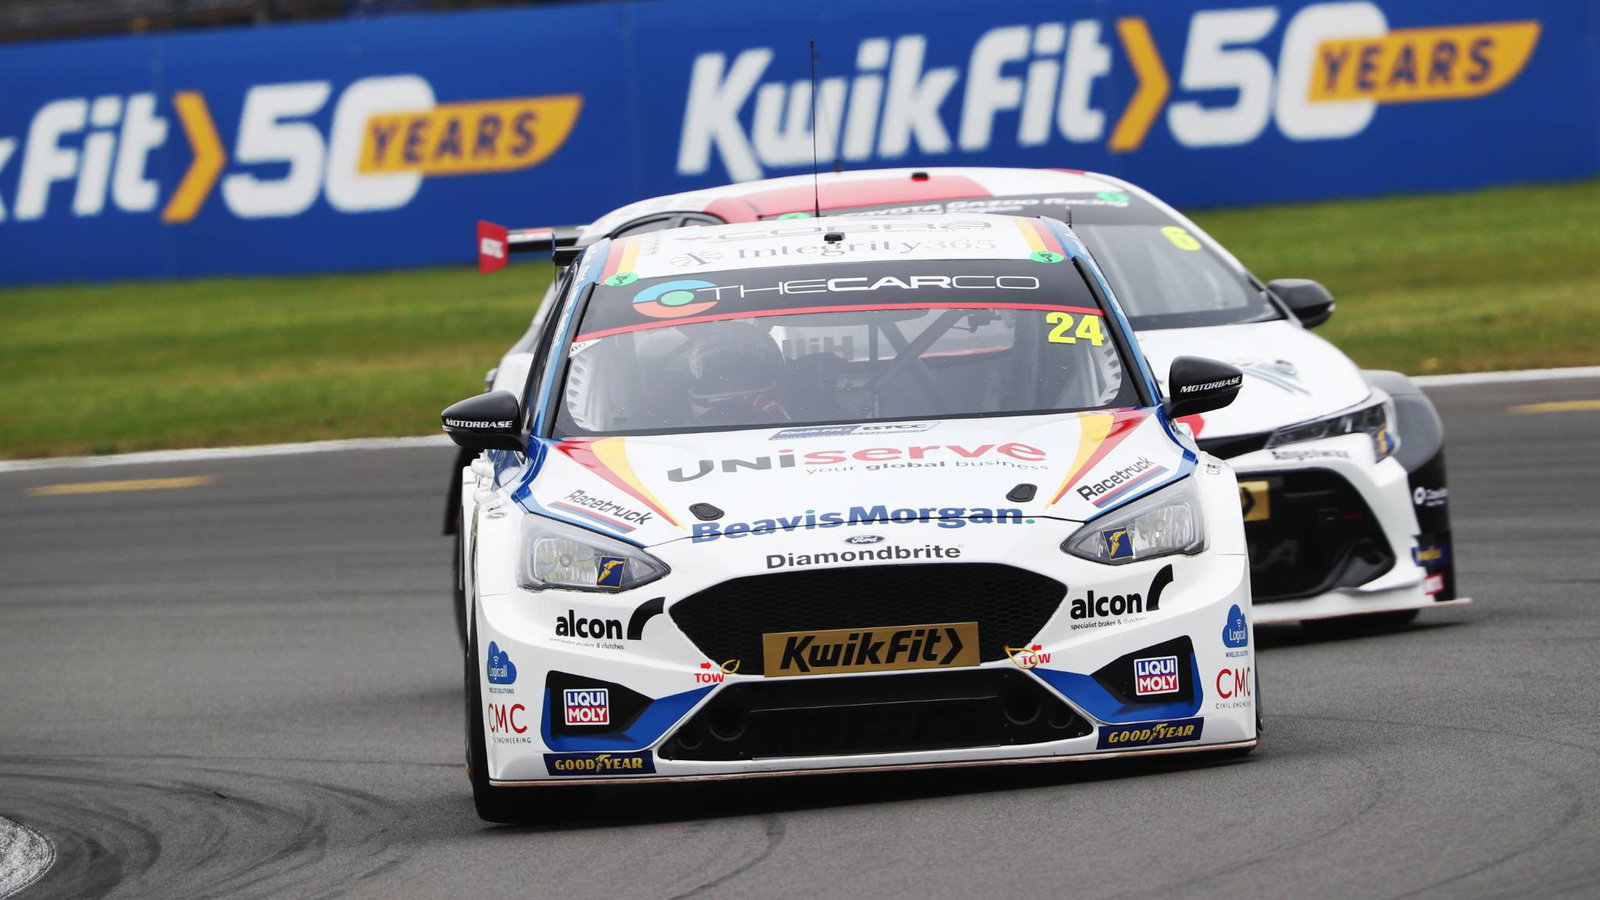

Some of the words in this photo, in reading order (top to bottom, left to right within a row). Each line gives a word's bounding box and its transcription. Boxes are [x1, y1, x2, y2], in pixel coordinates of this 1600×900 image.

[1167, 0, 1391, 148] 50
[1322, 37, 1495, 92] YEARS
[221, 74, 436, 219] 50
[371, 111, 541, 166] YEARS
[1160, 226, 1202, 250] 6
[1046, 312, 1104, 346] 24
[1180, 375, 1241, 393] MOTORBASE
[445, 418, 513, 429] MOTORBASE
[806, 466, 855, 476] your
[866, 461, 946, 472] global
[956, 460, 1050, 471] business
[1076, 456, 1155, 501] Racetruck
[564, 489, 653, 526] Racetruck
[851, 535, 878, 544] Ford
[766, 544, 961, 569] Diamondbrite
[1070, 590, 1142, 620] alcon
[555, 609, 623, 639] alcon
[1070, 621, 1097, 631] specialist
[1097, 618, 1116, 628] brakes
[1022, 652, 1051, 666] TOW
[1138, 660, 1175, 676] LIQUI
[694, 672, 725, 684] TOW
[1139, 675, 1176, 692] MOLY
[1216, 666, 1251, 699] CMC
[567, 692, 605, 706] LIQUI
[488, 703, 528, 734] CMC
[568, 707, 607, 722] MOLY
